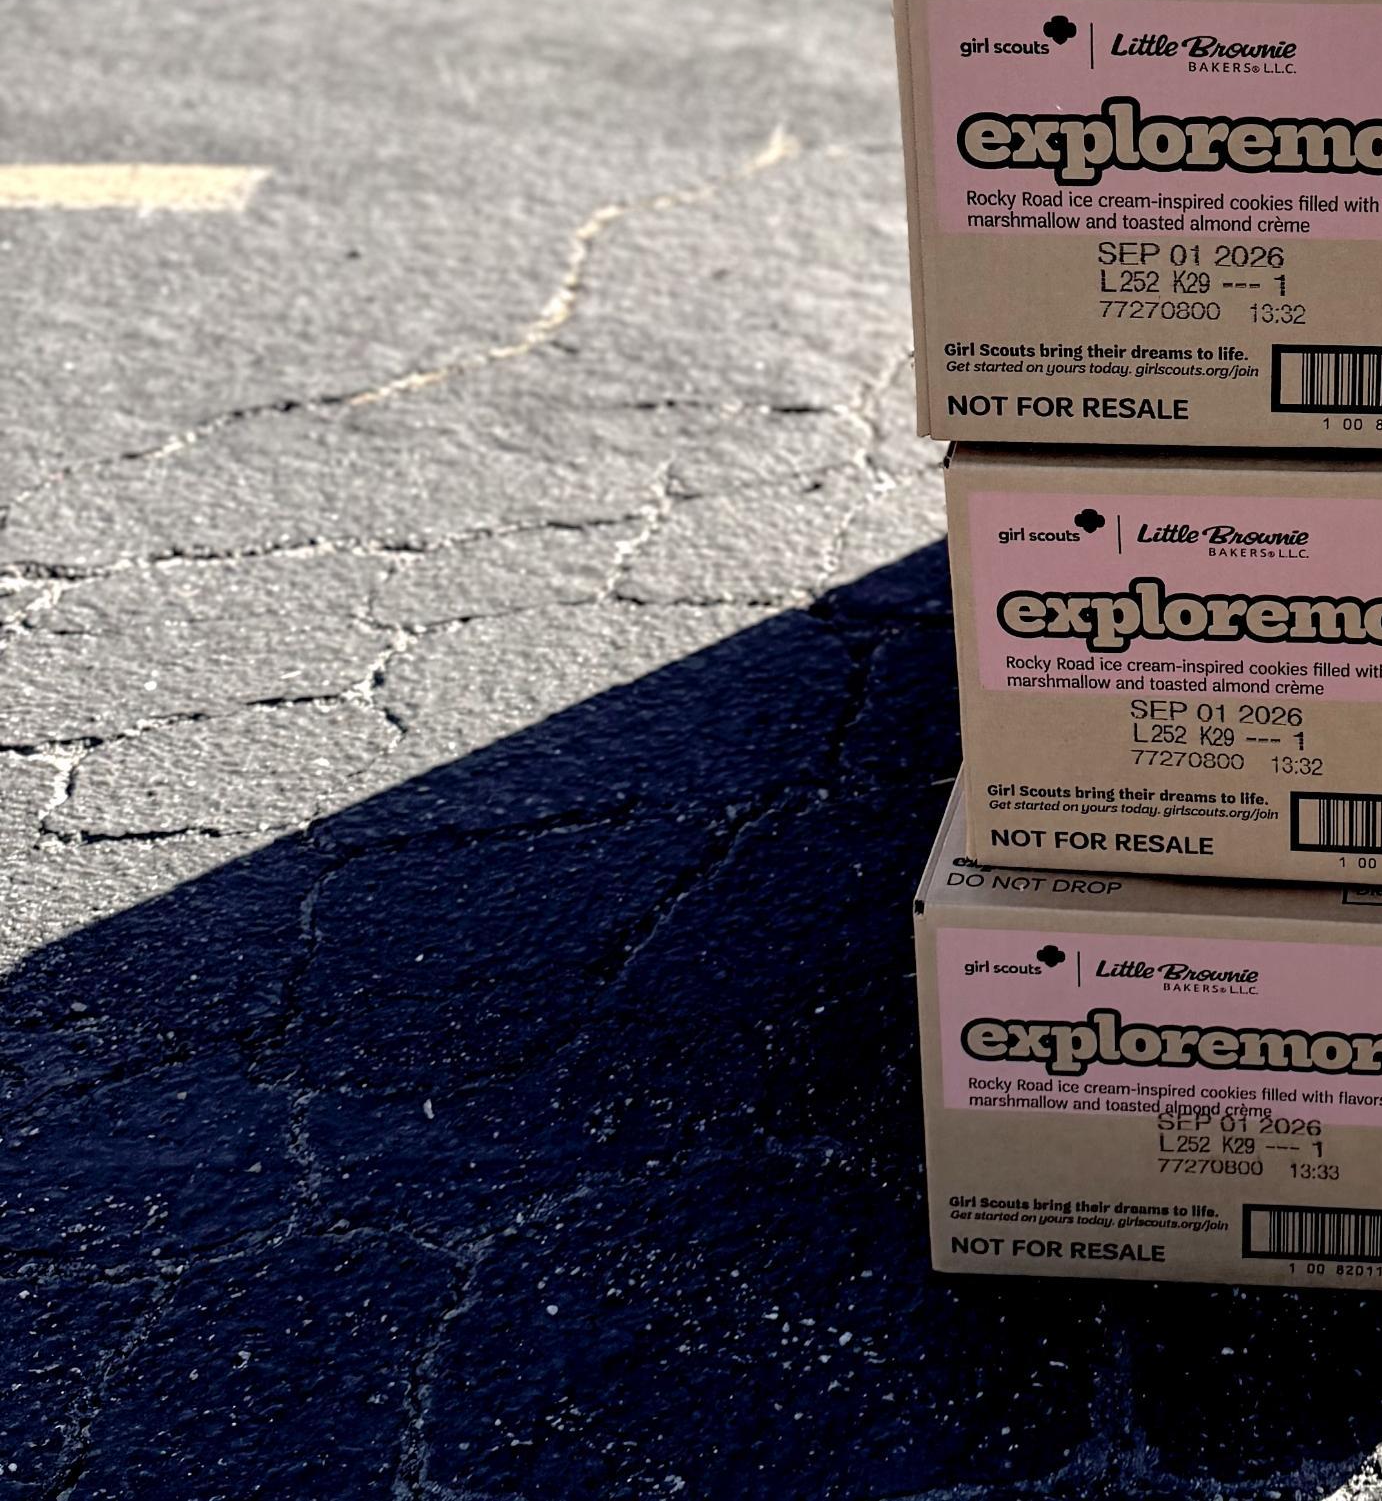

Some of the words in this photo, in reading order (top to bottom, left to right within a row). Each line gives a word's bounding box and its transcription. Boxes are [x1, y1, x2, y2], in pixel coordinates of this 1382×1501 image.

[960, 38, 989, 57] girl
[994, 41, 1049, 54] scouts
[1111, 34, 1178, 56] Little
[1182, 36, 1296, 58] Brownie
[968, 190, 1016, 210] Rocky
[1022, 190, 1062, 206] Road
[1069, 192, 1092, 207] ice
[1098, 193, 1224, 212] cream-inspired
[1230, 194, 1292, 210] cookies
[1299, 195, 1338, 212] filled
[1344, 196, 1378, 212] with
[968, 211, 1080, 228] marshmallow
[1086, 213, 1116, 228] and
[1122, 214, 1184, 230] toasted
[1190, 214, 1251, 231] almond
[1258, 216, 1310, 232] crème
[1098, 242, 1160, 265] SEP
[1170, 244, 1199, 266] 01
[1214, 245, 1284, 268] 2026
[1100, 300, 1220, 320] 77270800
[1250, 304, 1306, 324] 13:32
[948, 396, 1008, 416] NOT
[1018, 397, 1074, 417] FOR
[1083, 398, 1188, 419] RESALE
[999, 528, 1024, 544] girl
[1029, 530, 1080, 541] scouts
[1137, 524, 1199, 543] Little
[1202, 526, 1308, 545] Brownie
[1131, 700, 1187, 720] SEP
[1198, 704, 1224, 722] 01
[1240, 705, 1302, 726] 2026
[1132, 750, 1244, 770] 77270800
[1272, 756, 1322, 776] 13:32
[992, 830, 1046, 847] NOT
[1055, 832, 1107, 850] FOR
[1116, 834, 1213, 854] RESALE
[947, 872, 984, 887] DO
[992, 876, 1046, 891] NOT
[1052, 879, 1122, 894] DROP
[965, 960, 989, 975] girl
[994, 964, 1042, 974] scouts
[1096, 960, 1154, 978] Little
[1158, 964, 1258, 982] Brownie
[1158, 1110, 1212, 1130] SEP
[1220, 1115, 1249, 1134] 01
[1260, 1114, 1321, 1136] 2026
[1160, 1134, 1210, 1152] L252
[1223, 1136, 1254, 1154] K29
[1312, 1142, 1322, 1158] 1
[1158, 1158, 1262, 1175] 77270800
[1291, 1164, 1339, 1180] 13:33
[952, 1237, 1004, 1255] NOT
[1013, 1240, 1062, 1258] FOR
[1071, 1242, 1165, 1262] RESALE
